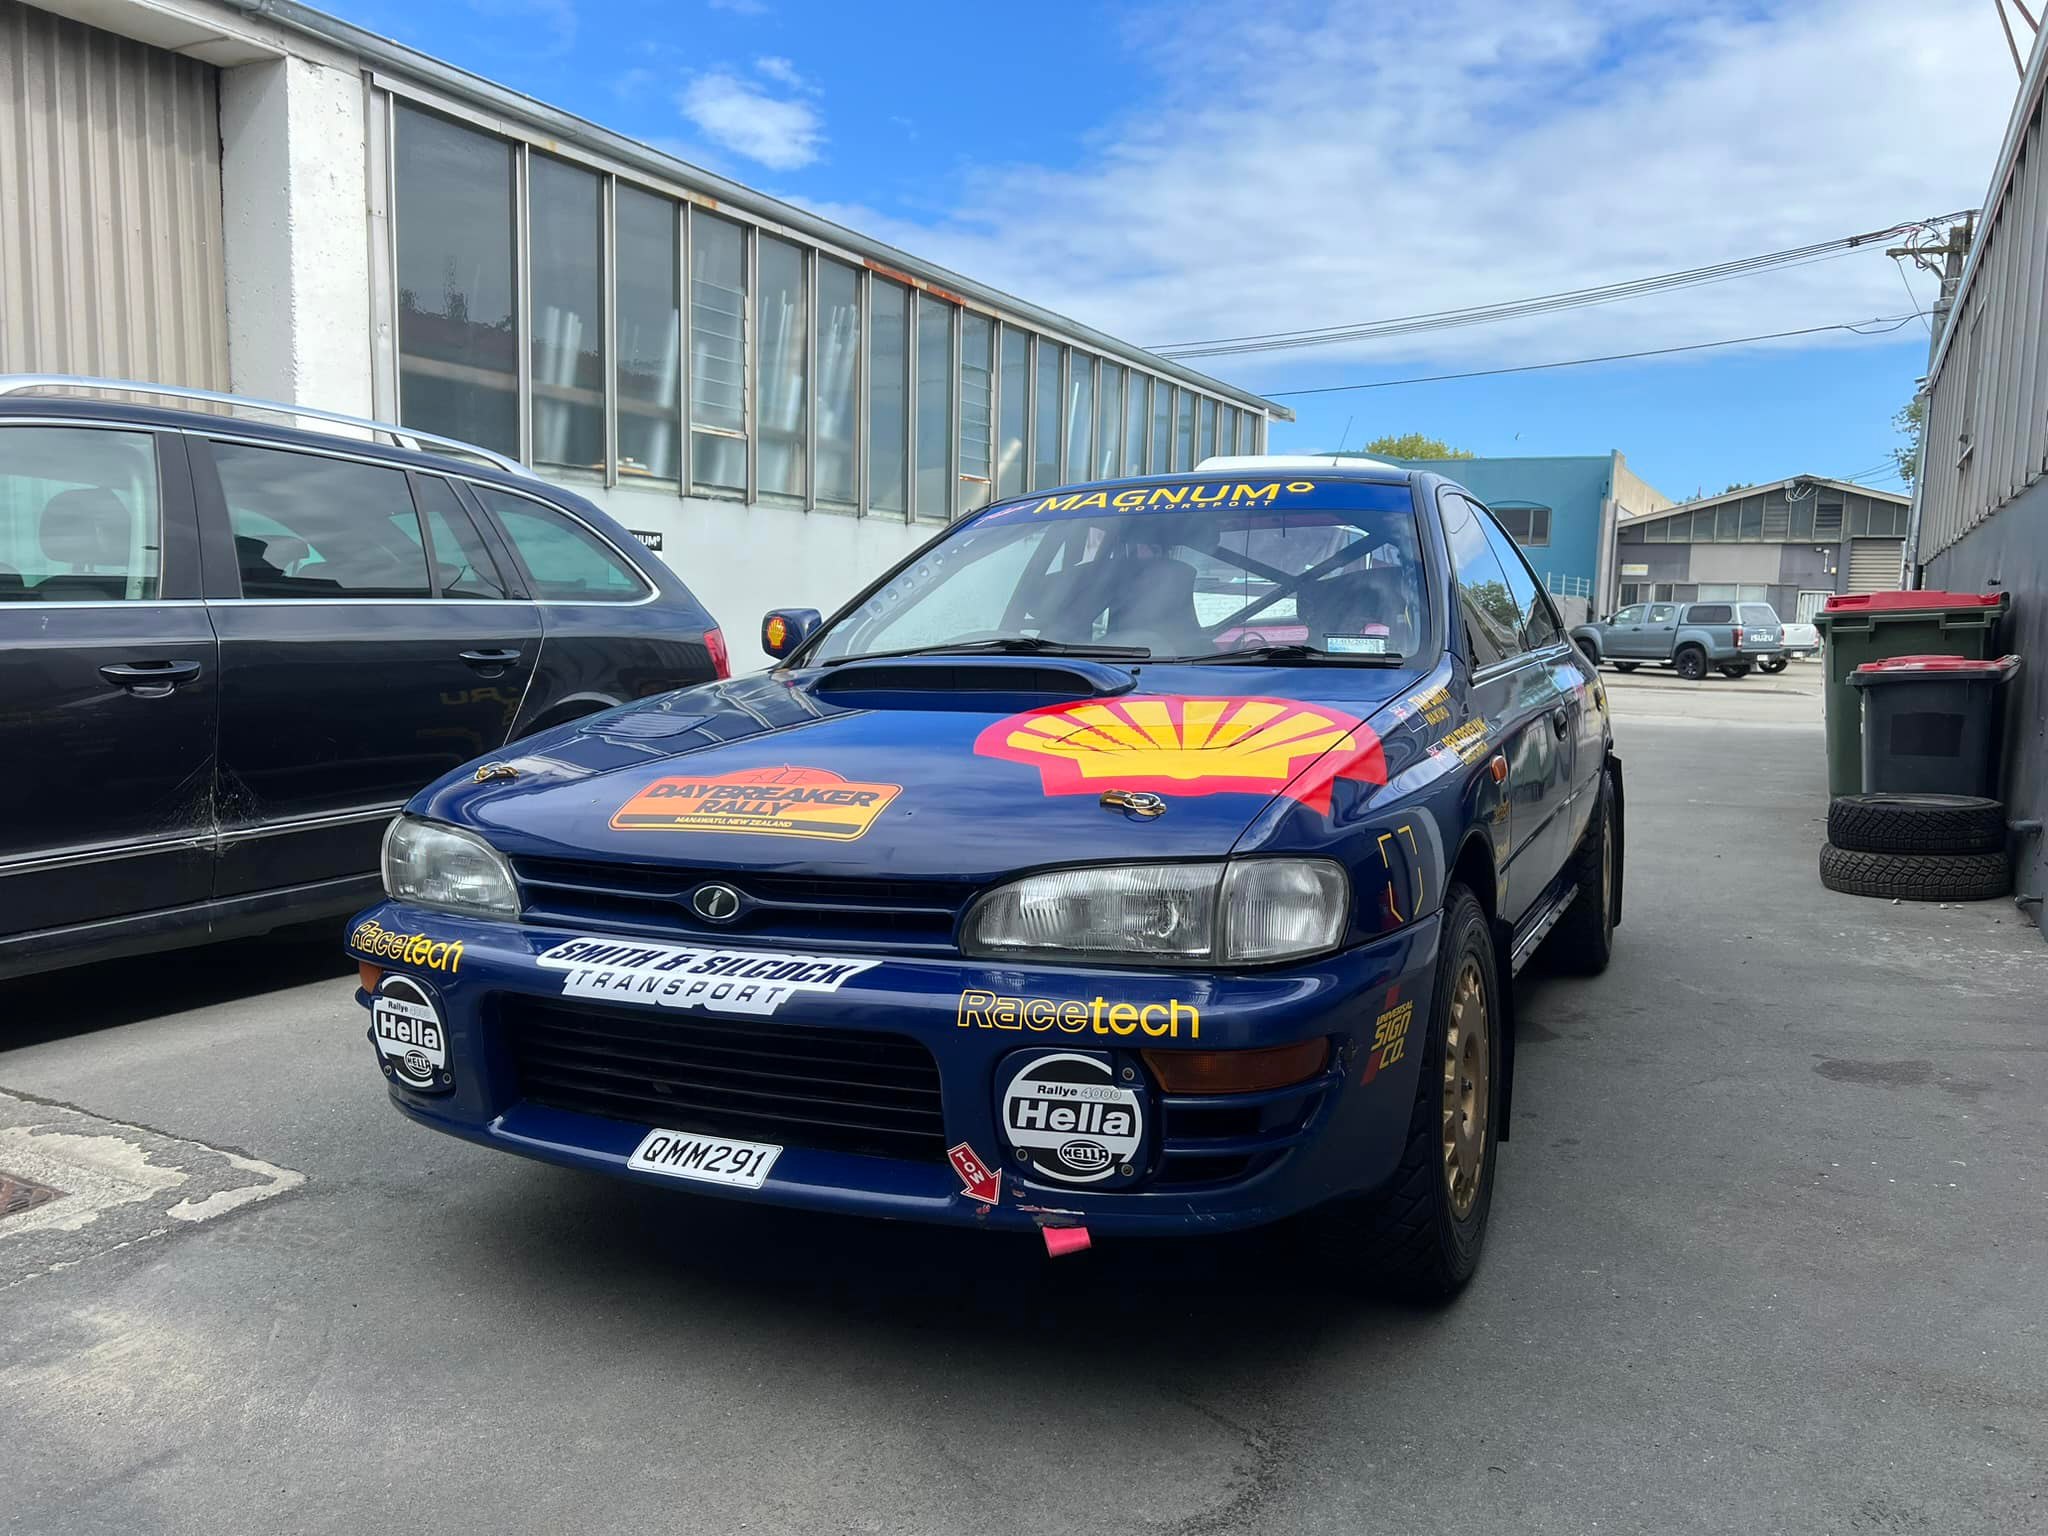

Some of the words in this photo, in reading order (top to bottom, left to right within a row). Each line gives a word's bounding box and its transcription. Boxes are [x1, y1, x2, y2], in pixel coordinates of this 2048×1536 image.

[1033, 483, 1280, 514] MAGNUM
[1118, 500, 1273, 513] MOTORSPORT
[1750, 634, 1774, 642] ISUZU
[645, 783, 881, 808] DAYBREAKER
[692, 799, 795, 816] RALLY
[727, 818, 749, 826] NEW
[749, 819, 793, 829] ZEALAND
[351, 920, 464, 974] Racetech
[549, 942, 657, 969] SMITH
[653, 953, 696, 971] &
[687, 955, 859, 984] SILCOCK
[575, 969, 786, 1004] TRANSPORT
[388, 1000, 409, 1013] Rallye
[957, 989, 1200, 1039] Racetech
[380, 1012, 439, 1049] Hella
[407, 1055, 432, 1072] HELLA
[1037, 1084, 1078, 1097] Rallye
[1080, 1087, 1122, 1101] 4000
[1016, 1099, 1131, 1136] Hella
[643, 1136, 767, 1178] QMM291
[954, 1150, 986, 1185] TOW
[1063, 1147, 1110, 1162] HELLA
